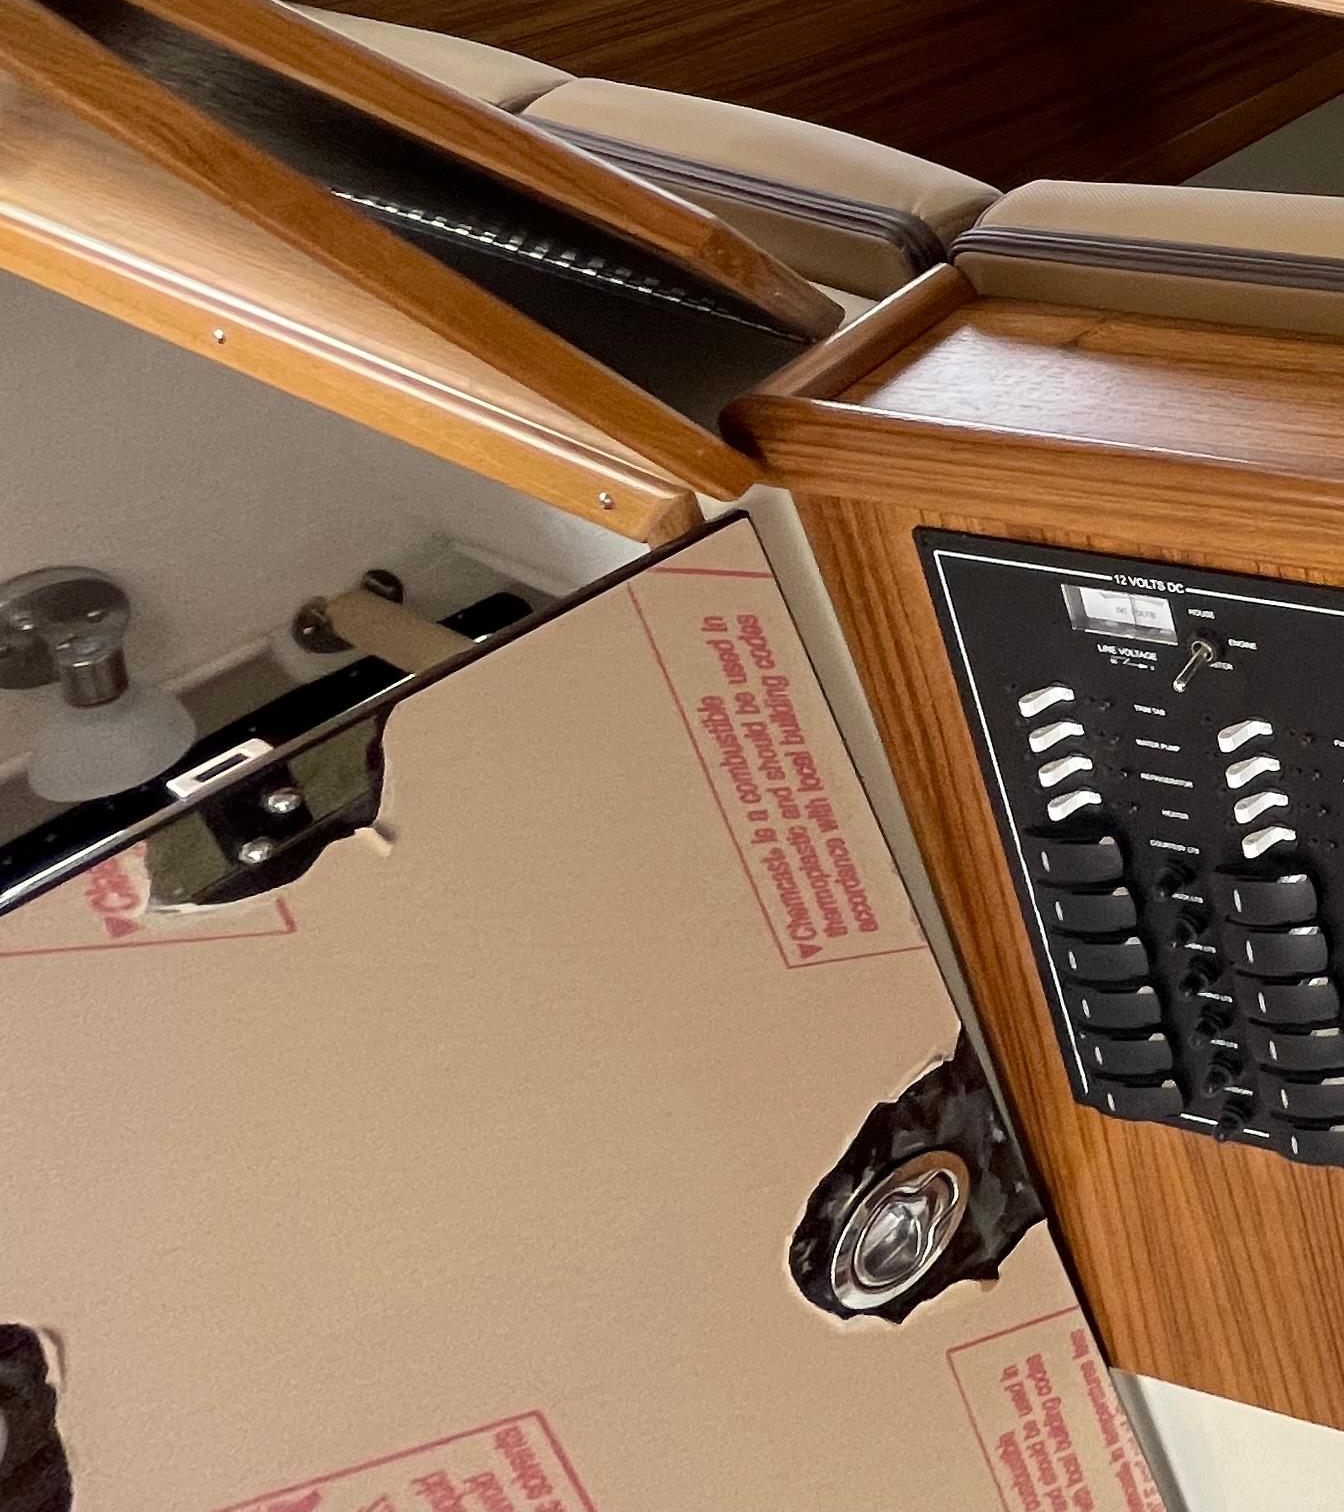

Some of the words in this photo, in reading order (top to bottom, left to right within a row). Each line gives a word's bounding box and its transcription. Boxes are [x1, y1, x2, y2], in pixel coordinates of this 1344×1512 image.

[1114, 574, 1127, 586] 12
[1128, 576, 1166, 592] VOLTS
[1165, 582, 1185, 594] DC
[701, 615, 728, 632] in
[736, 614, 775, 670] codes
[705, 639, 747, 684] used
[1097, 644, 1117, 655] LINE
[1118, 648, 1157, 661] VOLTAGE
[735, 691, 760, 714] be
[761, 675, 805, 745] building
[696, 695, 762, 804] combustible
[741, 721, 786, 780] should
[784, 750, 824, 792] local
[765, 787, 801, 820] and
[804, 797, 839, 833] with
[751, 828, 778, 844] is
[786, 825, 848, 938] thermoplastic
[825, 837, 879, 933] accordance
